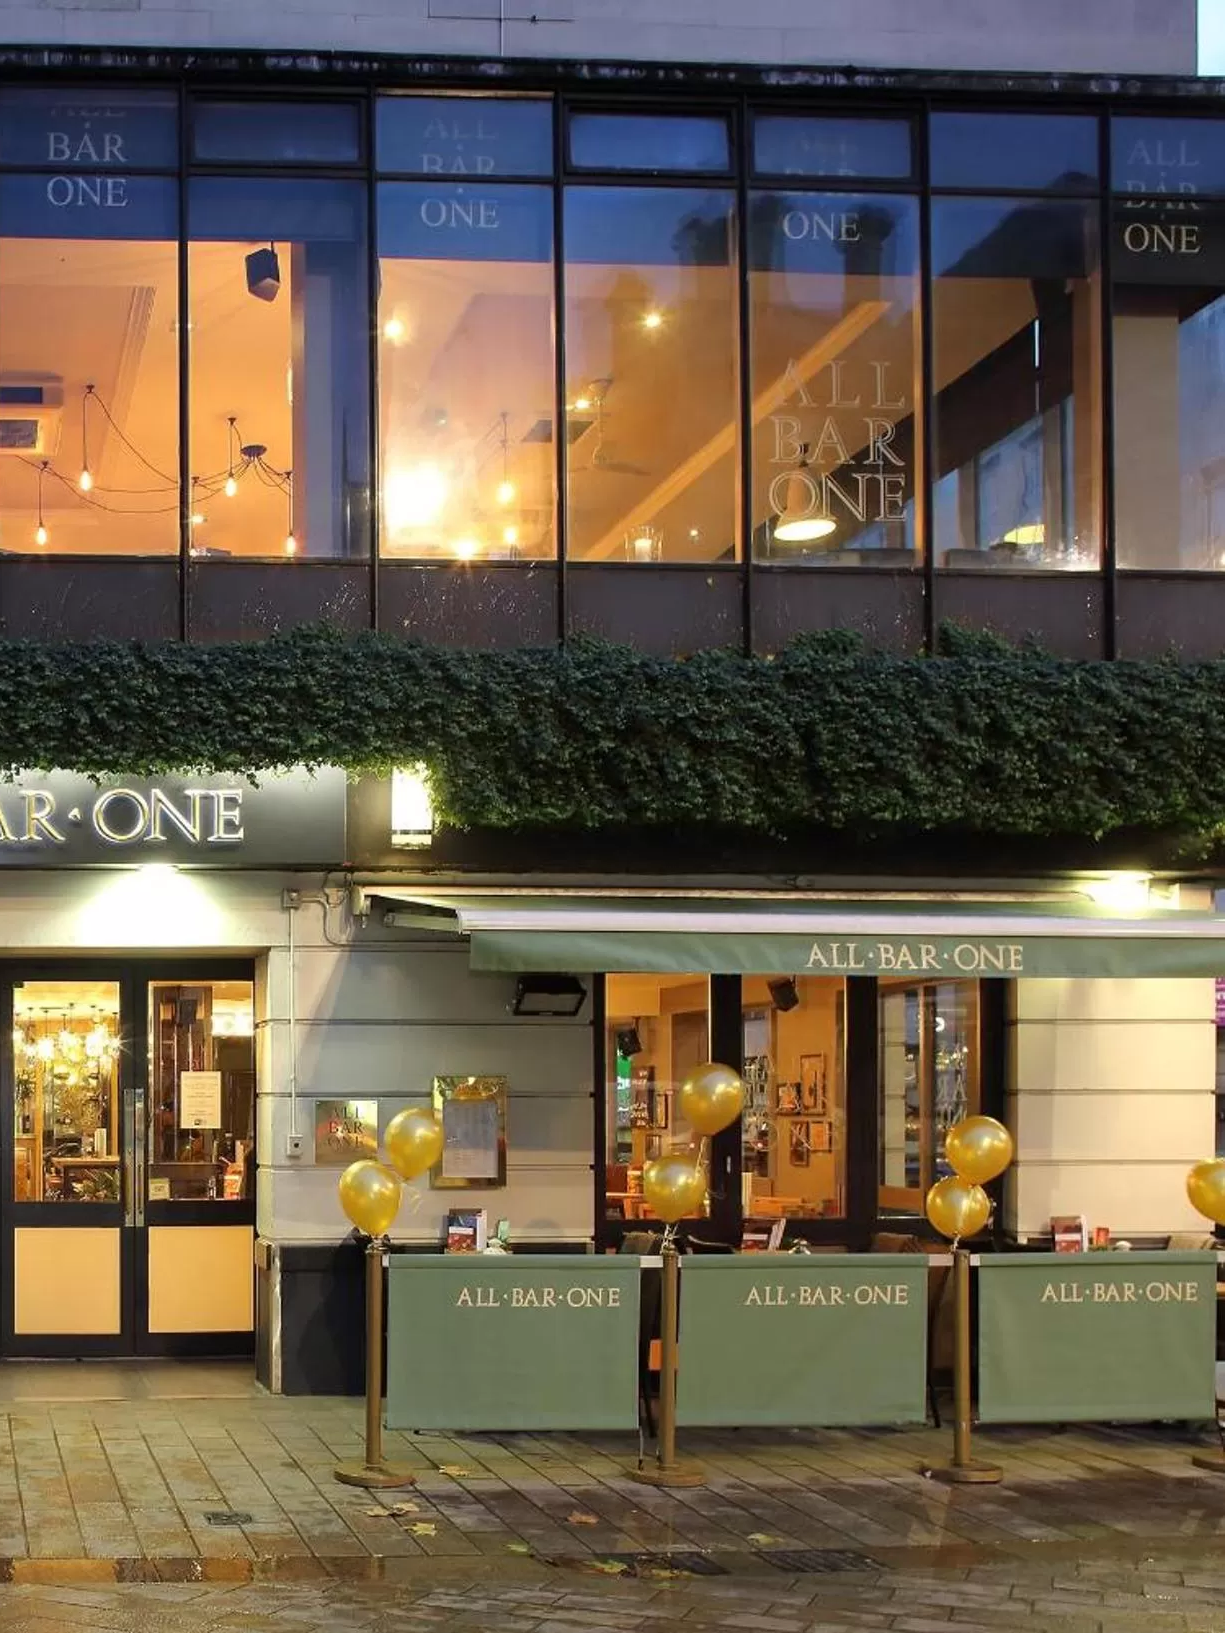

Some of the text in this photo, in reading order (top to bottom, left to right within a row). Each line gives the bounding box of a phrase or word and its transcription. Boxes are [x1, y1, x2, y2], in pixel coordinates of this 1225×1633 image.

[46, 131, 129, 163] BAR
[1126, 139, 1201, 167] ALL
[46, 175, 129, 207] ONE
[420, 198, 500, 229] ONE
[782, 210, 861, 241] ONE
[1123, 222, 1201, 254] ONE
[773, 357, 907, 409] ALL
[769, 414, 907, 467] BAR
[768, 470, 908, 523] ONE
[92, 787, 245, 843] ONE
[805, 943, 1024, 972] ALL BAR ONE
[329, 1121, 364, 1134] BAR
[456, 1286, 620, 1308] ALL BAR ONE
[744, 1284, 909, 1306] ALL BAR ONE
[1041, 1281, 1199, 1302] ALL BAR ONE
